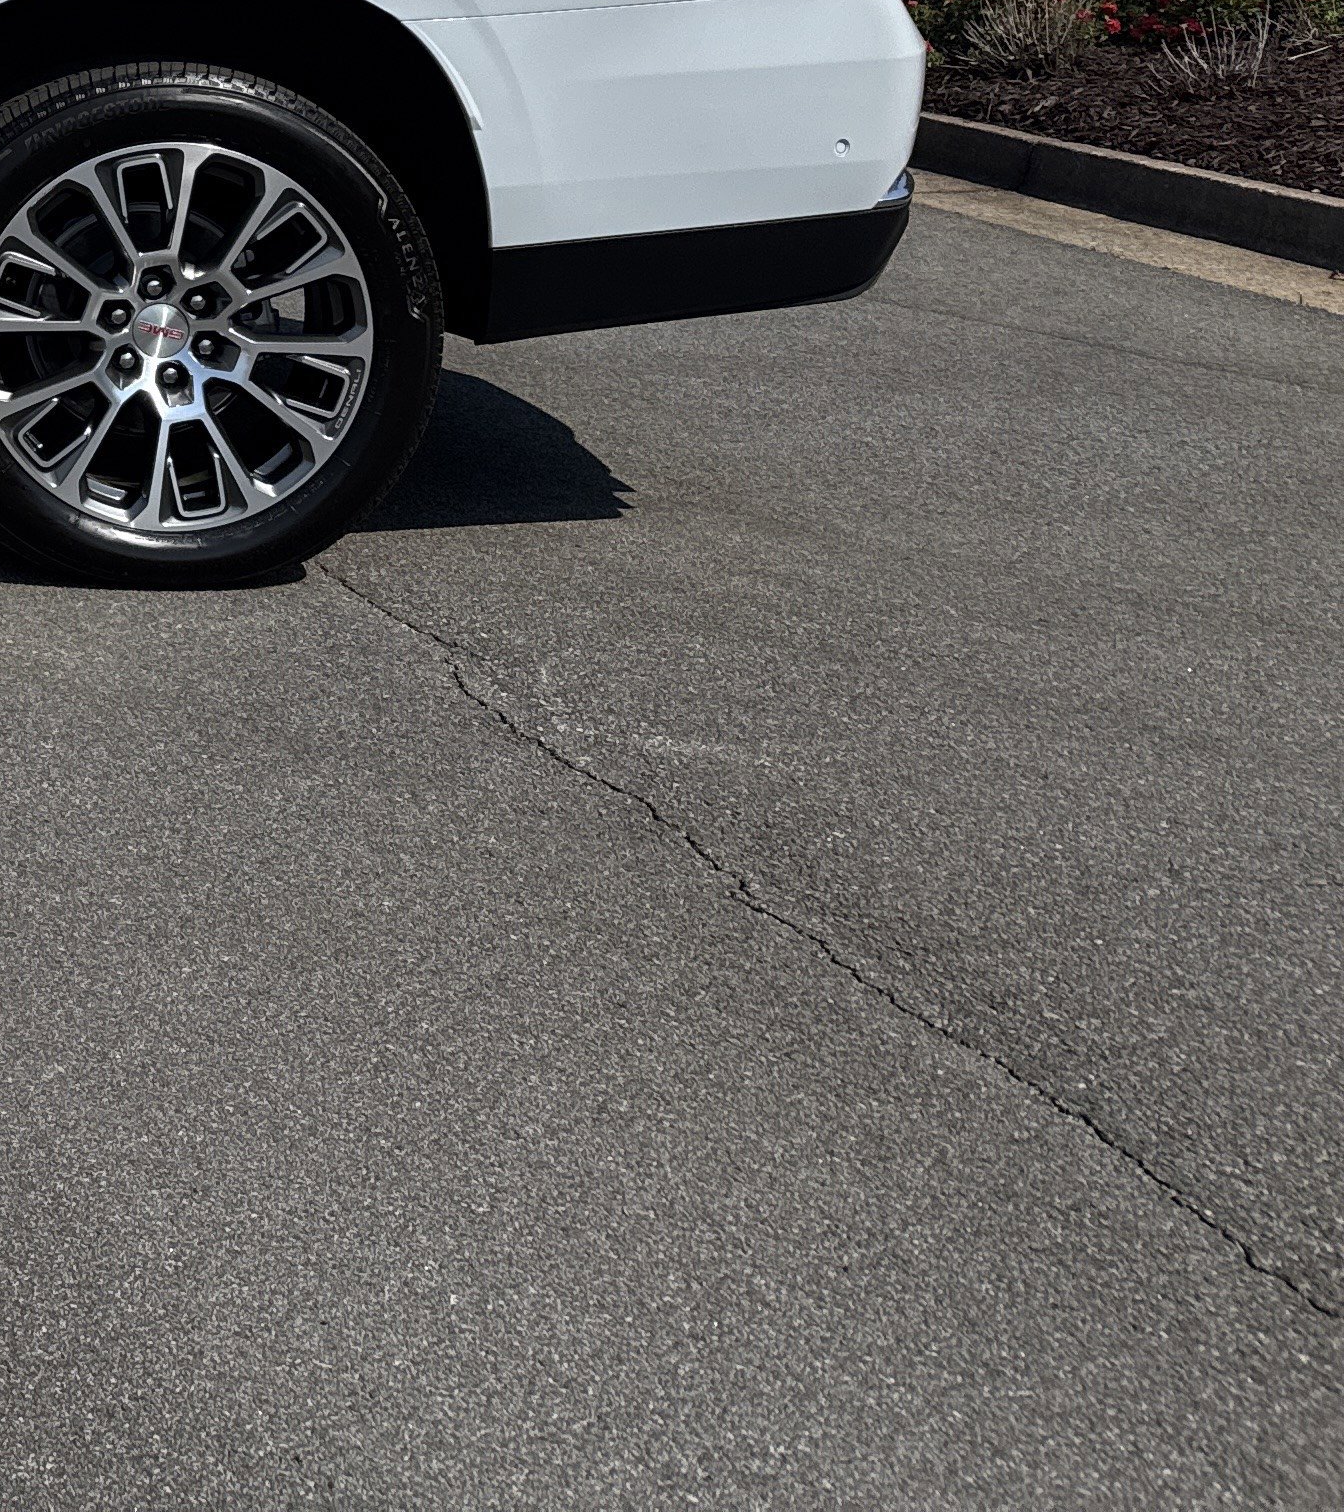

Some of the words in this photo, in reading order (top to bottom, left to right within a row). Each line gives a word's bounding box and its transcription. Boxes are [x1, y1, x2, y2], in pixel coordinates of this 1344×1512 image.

[387, 218, 427, 305] ALENZA
[138, 320, 185, 340] GMC
[334, 369, 362, 429] DENALI
